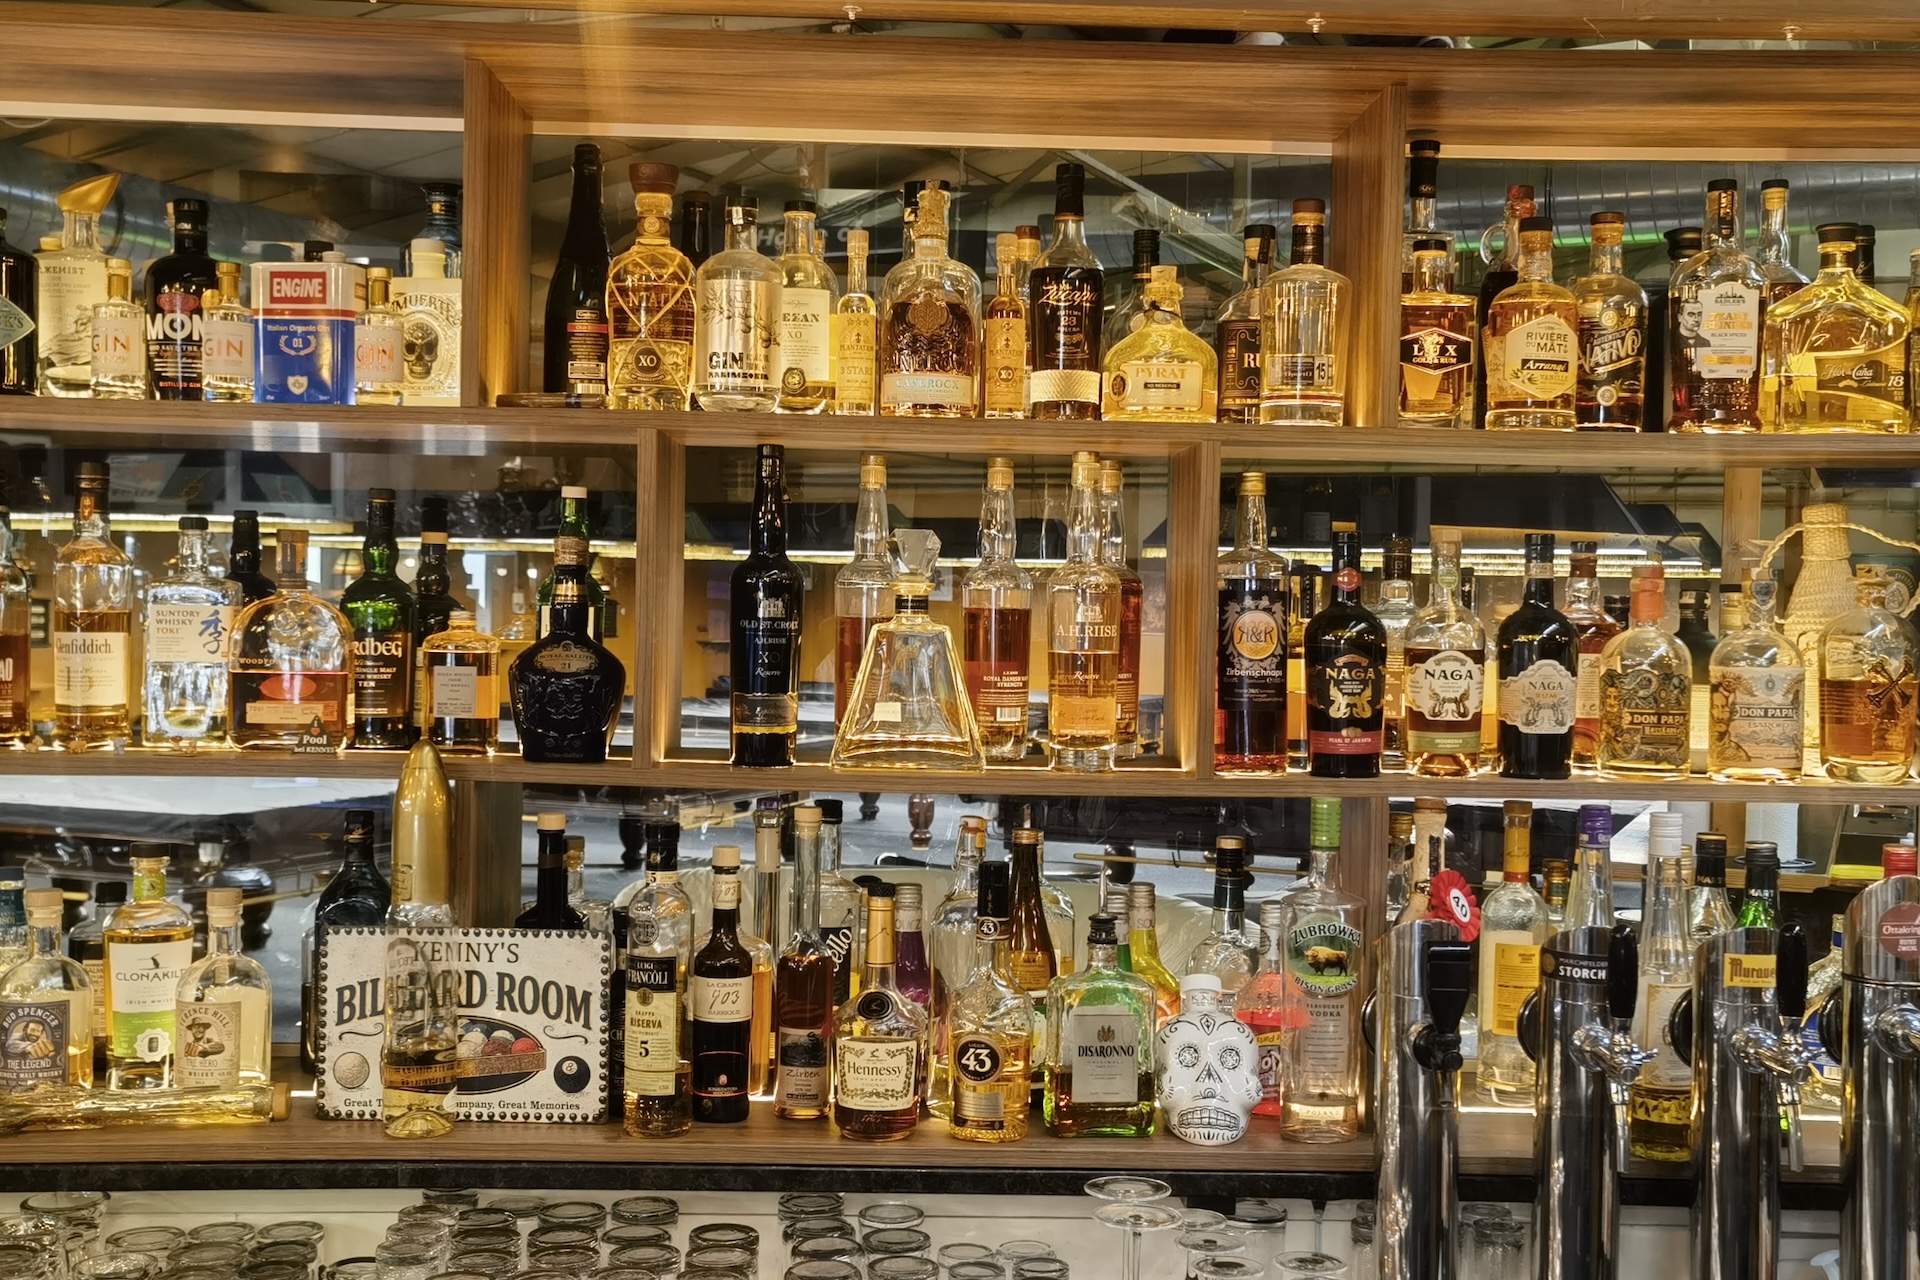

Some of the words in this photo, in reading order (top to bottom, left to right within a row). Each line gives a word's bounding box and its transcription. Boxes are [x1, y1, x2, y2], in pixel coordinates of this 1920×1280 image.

[272, 277, 324, 298] ENGINE
[1061, 316, 1077, 326] 23
[267, 324, 289, 332] Italian
[289, 325, 316, 333] Organic
[92, 333, 130, 353] GIN
[204, 338, 243, 358] GIN
[357, 340, 394, 363] GIN
[638, 355, 657, 367] XO
[708, 351, 744, 370] GIN
[1523, 359, 1567, 374] Arrangé
[840, 366, 845, 375] 3
[846, 365, 873, 376] STARS
[999, 369, 1013, 379] XO
[1135, 367, 1188, 380] PYRAT
[1315, 362, 1326, 380] 15
[1851, 363, 1874, 380] Caña
[895, 378, 959, 390] CANEROCK
[1539, 374, 1568, 382] VANILLE
[1887, 375, 1905, 387] 18
[155, 609, 201, 617] SUNTORY
[155, 618, 194, 626] WHISKY
[739, 619, 758, 629] OLD
[1056, 624, 1118, 638] A.H.RIISE
[560, 662, 572, 670] 21
[755, 667, 782, 679] Reserve
[1073, 670, 1100, 682] Reserve
[1226, 667, 1283, 679] Zirbenschnaps
[1325, 668, 1376, 680] NAGA
[1424, 668, 1475, 681] NAGA
[64, 666, 95, 693] 15
[1527, 681, 1564, 691] NAGA
[1741, 708, 1766, 717] DON
[1767, 707, 1794, 717] PAPA
[1632, 714, 1658, 724] DON
[1660, 714, 1687, 726] PAPA
[302, 734, 327, 745] Pool
[649, 872, 657, 883] 5
[1452, 895, 1468, 920] 40
[980, 921, 995, 934] 43
[411, 940, 520, 964] KENNY'S
[636, 962, 654, 970] LUIGI
[1558, 965, 1607, 980] STORCH
[1293, 976, 1325, 993] BISON
[1326, 977, 1359, 994] GRASS
[496, 971, 594, 1031] ROOM
[709, 988, 740, 1011] 903
[2, 1012, 17, 1029] BUD
[17, 1006, 60, 1028] SPENCER
[211, 1010, 231, 1029] HILL
[1310, 1010, 1342, 1018] VODKA
[630, 1017, 663, 1029] RISERVA
[638, 1039, 650, 1058] 5
[1077, 1045, 1135, 1059] DISARONNO
[7, 1059, 20, 1070] THE
[21, 1058, 52, 1069] LEGEND
[199, 1059, 218, 1068] HERO
[960, 1047, 992, 1073] 43
[565, 1061, 575, 1073] 8
[847, 1061, 904, 1078] Hennessy
[19, 1070, 37, 1079] MALT
[38, 1069, 63, 1079] WHISKY
[786, 1068, 821, 1079] Zirben
[343, 1098, 373, 1107] Great
[455, 1101, 496, 1111] ompany,
[498, 1099, 528, 1110] Great
[530, 1099, 581, 1111] Memories
